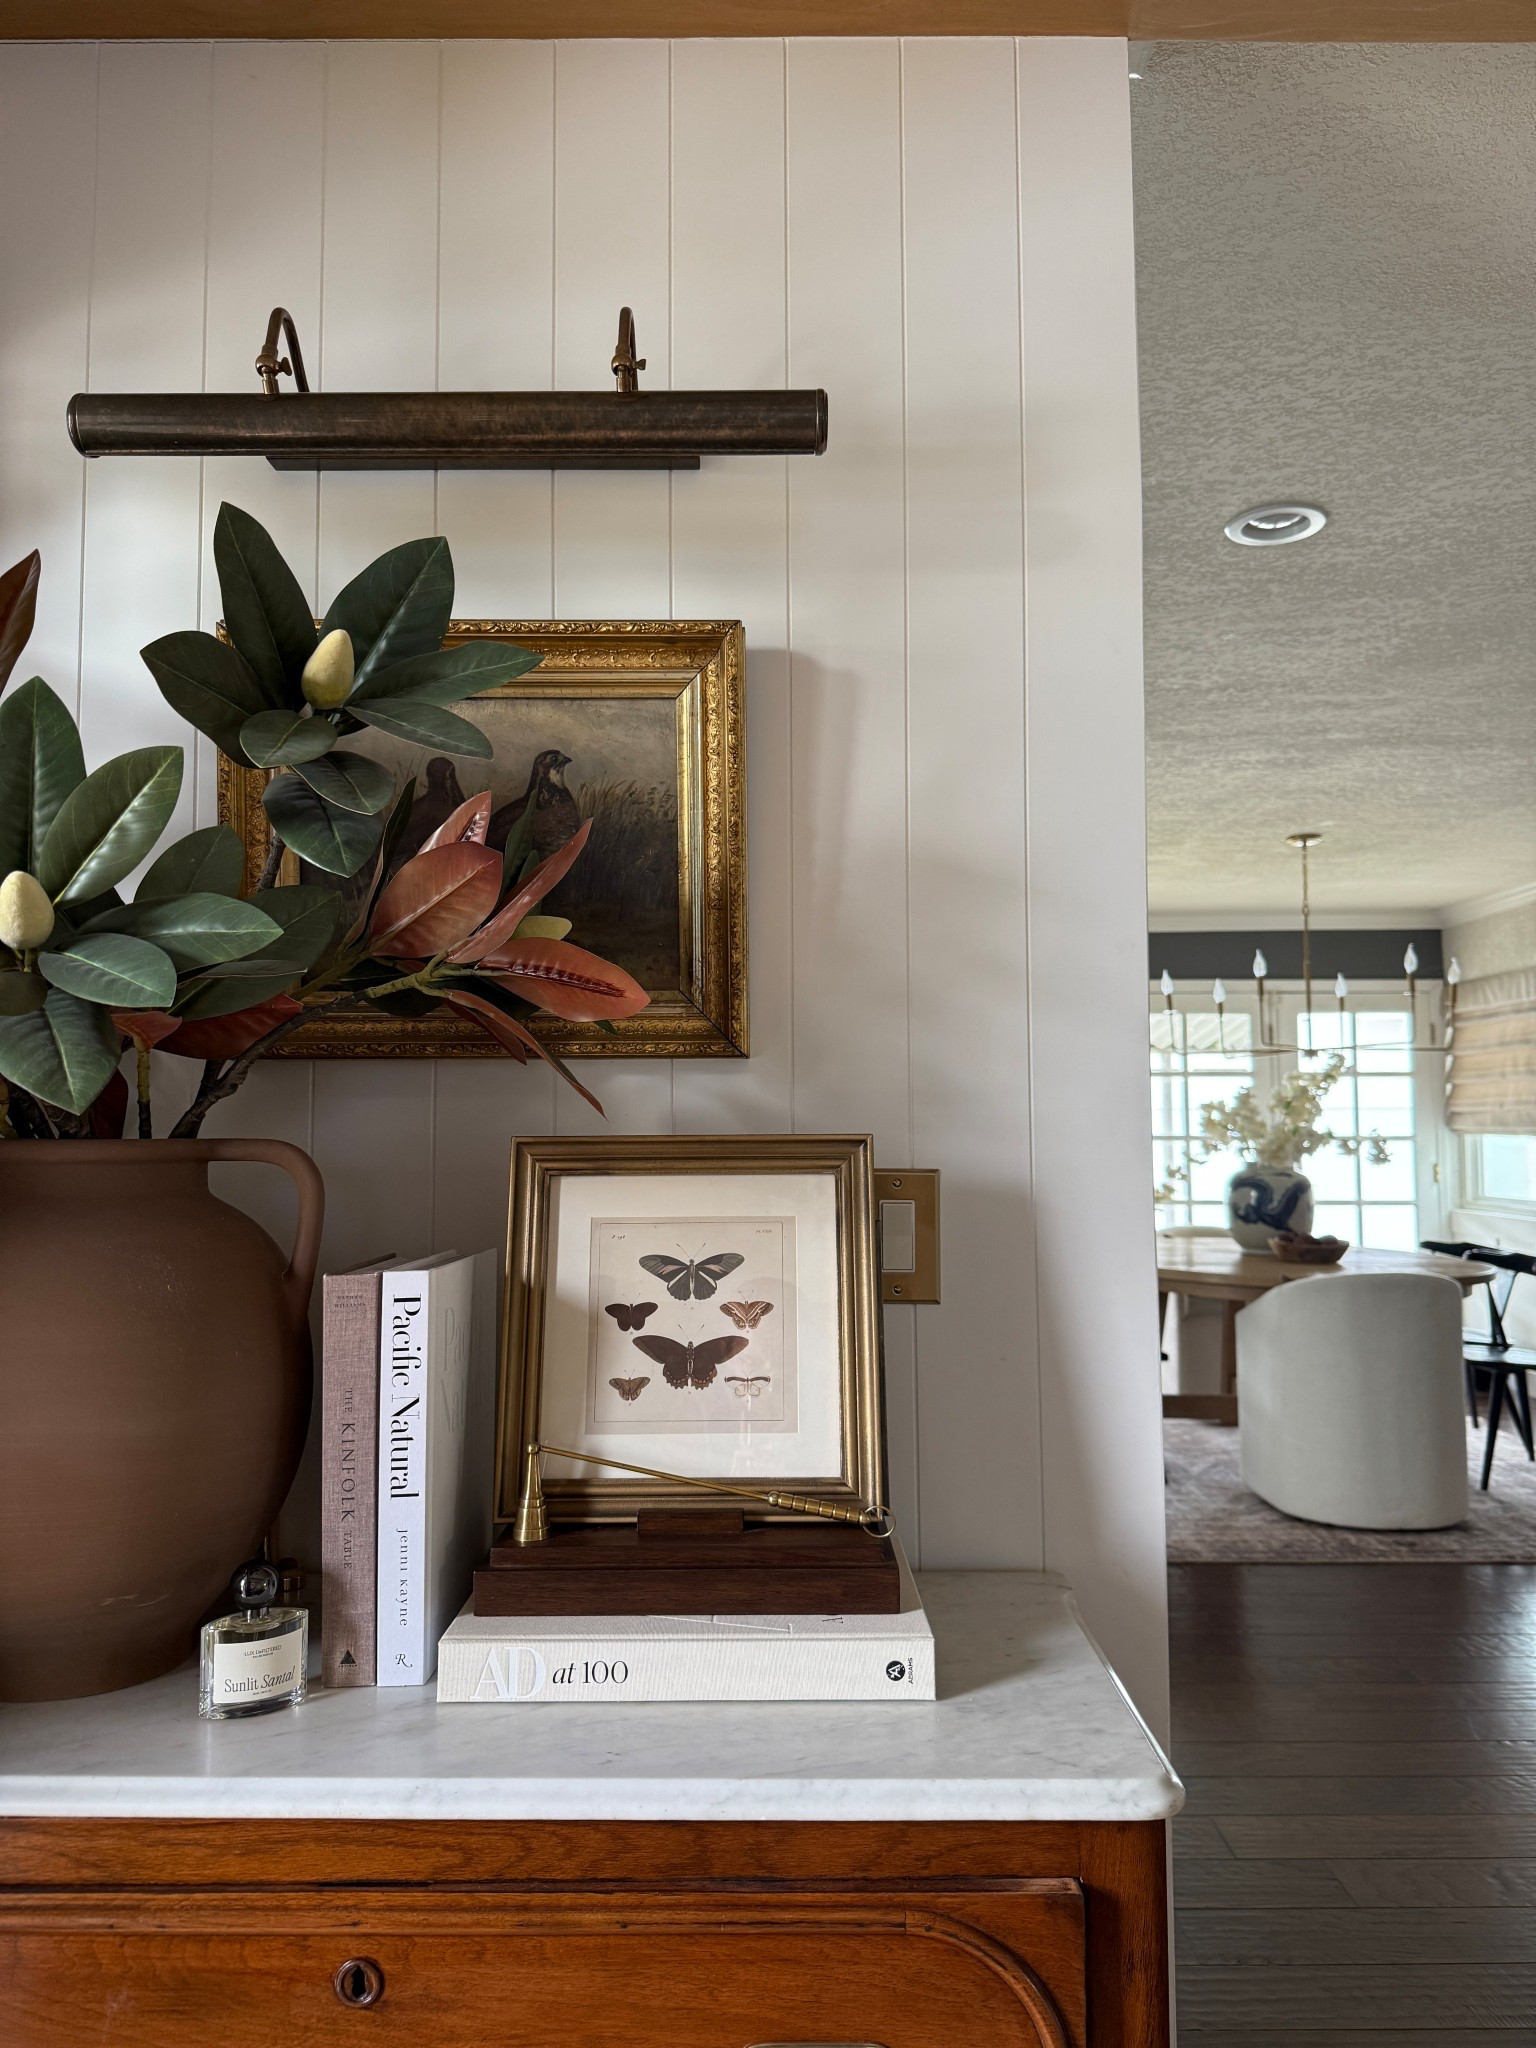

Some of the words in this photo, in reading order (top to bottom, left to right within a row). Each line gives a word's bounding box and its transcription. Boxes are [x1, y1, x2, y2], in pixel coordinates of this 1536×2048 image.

[391, 1293, 422, 1388] Pacific
[344, 1389, 353, 1413] THE
[341, 1422, 356, 1522] KINFOLK
[390, 1394, 421, 1500] Natural
[343, 1530, 352, 1569] TABLE
[224, 1677, 259, 1693] Sunlit
[260, 1665, 296, 1689] Santal
[469, 1645, 547, 1700] AD
[552, 1662, 576, 1684] at
[582, 1660, 629, 1684] 100
